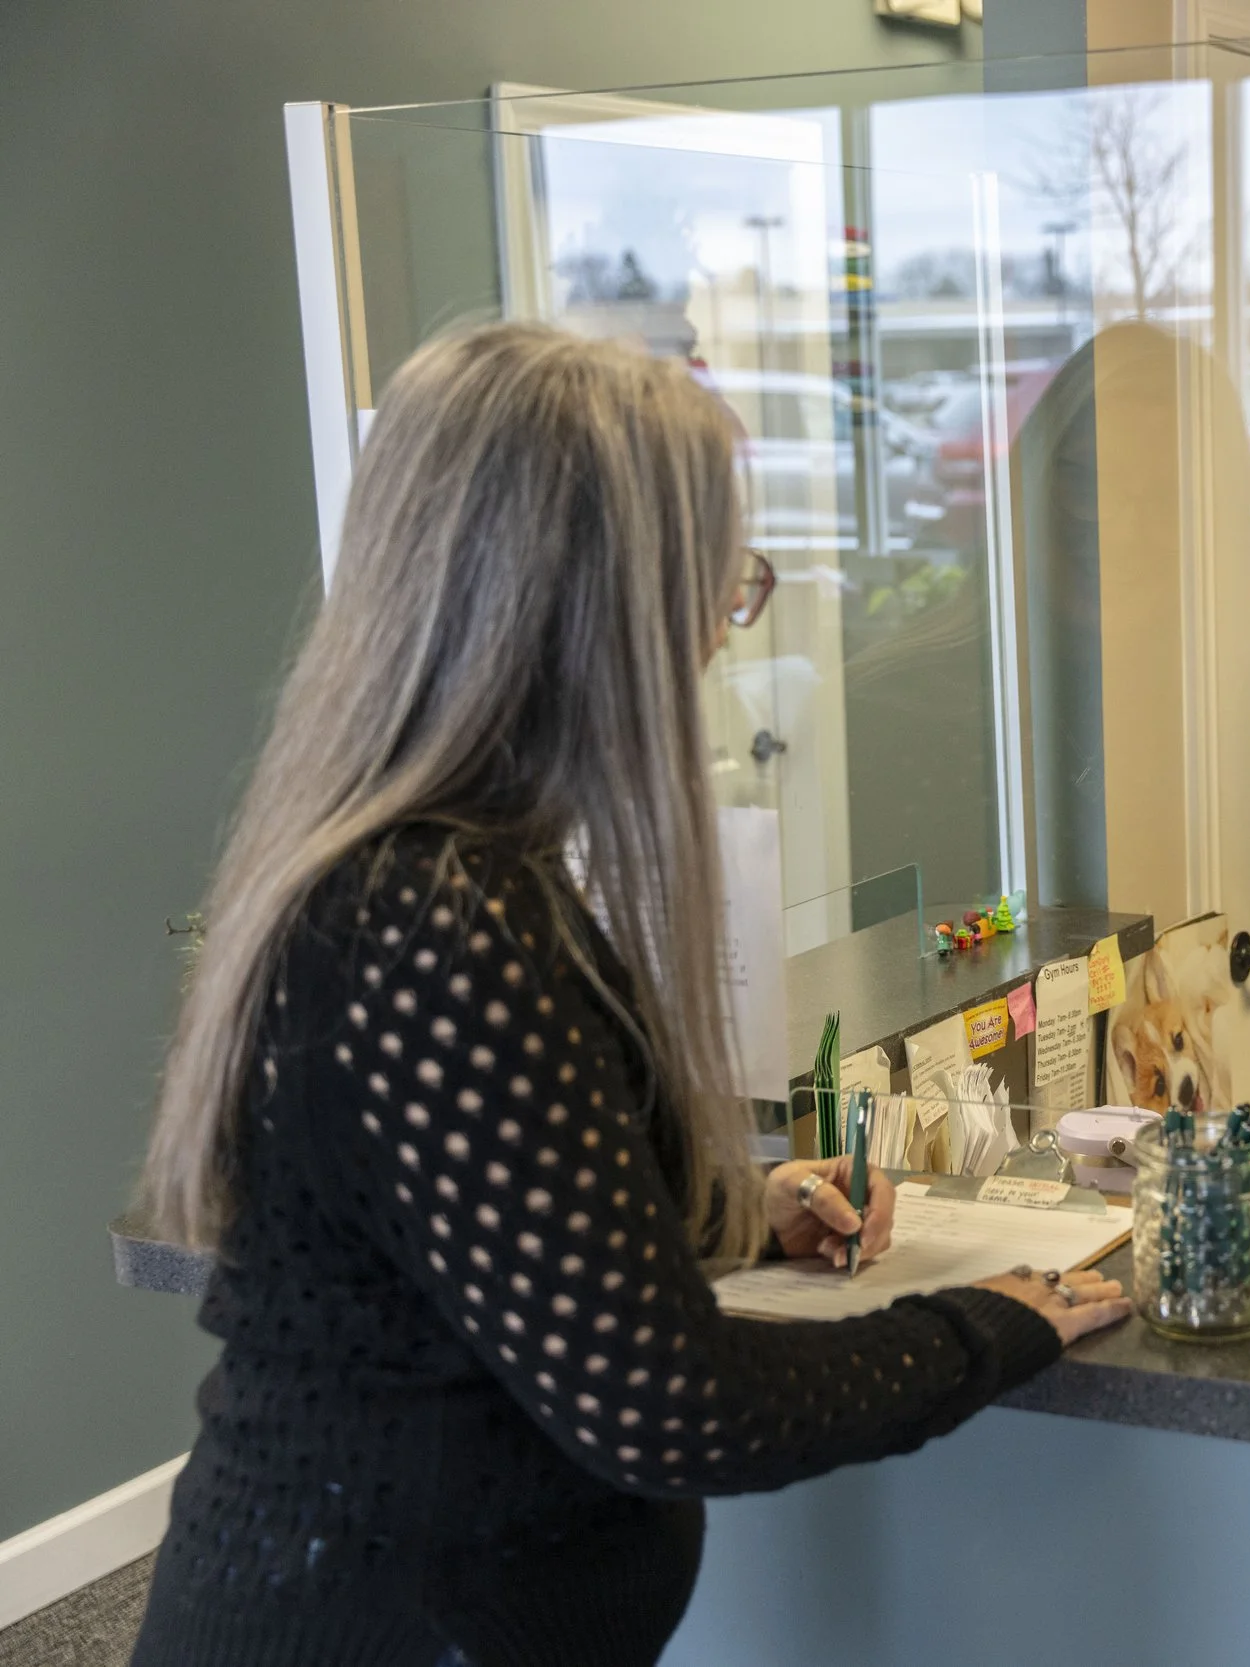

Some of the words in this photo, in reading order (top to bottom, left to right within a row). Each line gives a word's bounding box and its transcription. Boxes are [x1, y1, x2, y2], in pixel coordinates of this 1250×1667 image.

[1044, 969, 1060, 982] Gym
[1060, 963, 1079, 976] Hours
[971, 1021, 986, 1035] You
[988, 1015, 1002, 1028] Are
[1038, 1019, 1055, 1029] Monday
[969, 1029, 1005, 1049] Awesome!
[1038, 1032, 1056, 1043] Tuesday
[1038, 1043, 1061, 1056] Wednesday
[1037, 1057, 1057, 1069] Thursday
[1037, 1073, 1050, 1083] Friday
